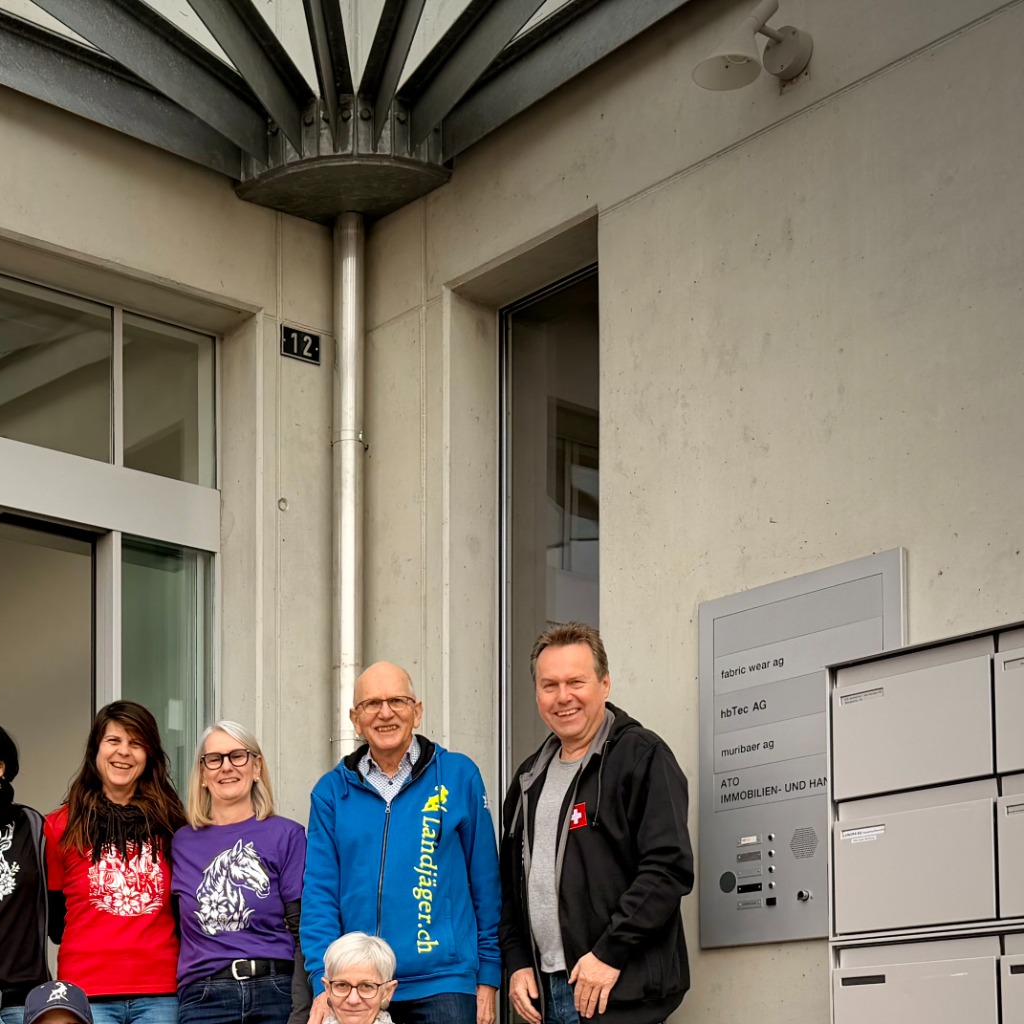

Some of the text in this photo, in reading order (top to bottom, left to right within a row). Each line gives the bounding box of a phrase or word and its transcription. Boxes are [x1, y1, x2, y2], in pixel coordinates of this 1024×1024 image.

[291, 333, 312, 357] 12
[721, 658, 784, 679] fabric wear ag
[721, 700, 766, 718] hbTec AG
[722, 740, 774, 757] muribaer ag
[721, 777, 739, 788] ATO
[721, 786, 781, 803] IMMOBILIEN-
[785, 781, 806, 792] UND
[413, 816, 440, 953] Landjäger.ch
